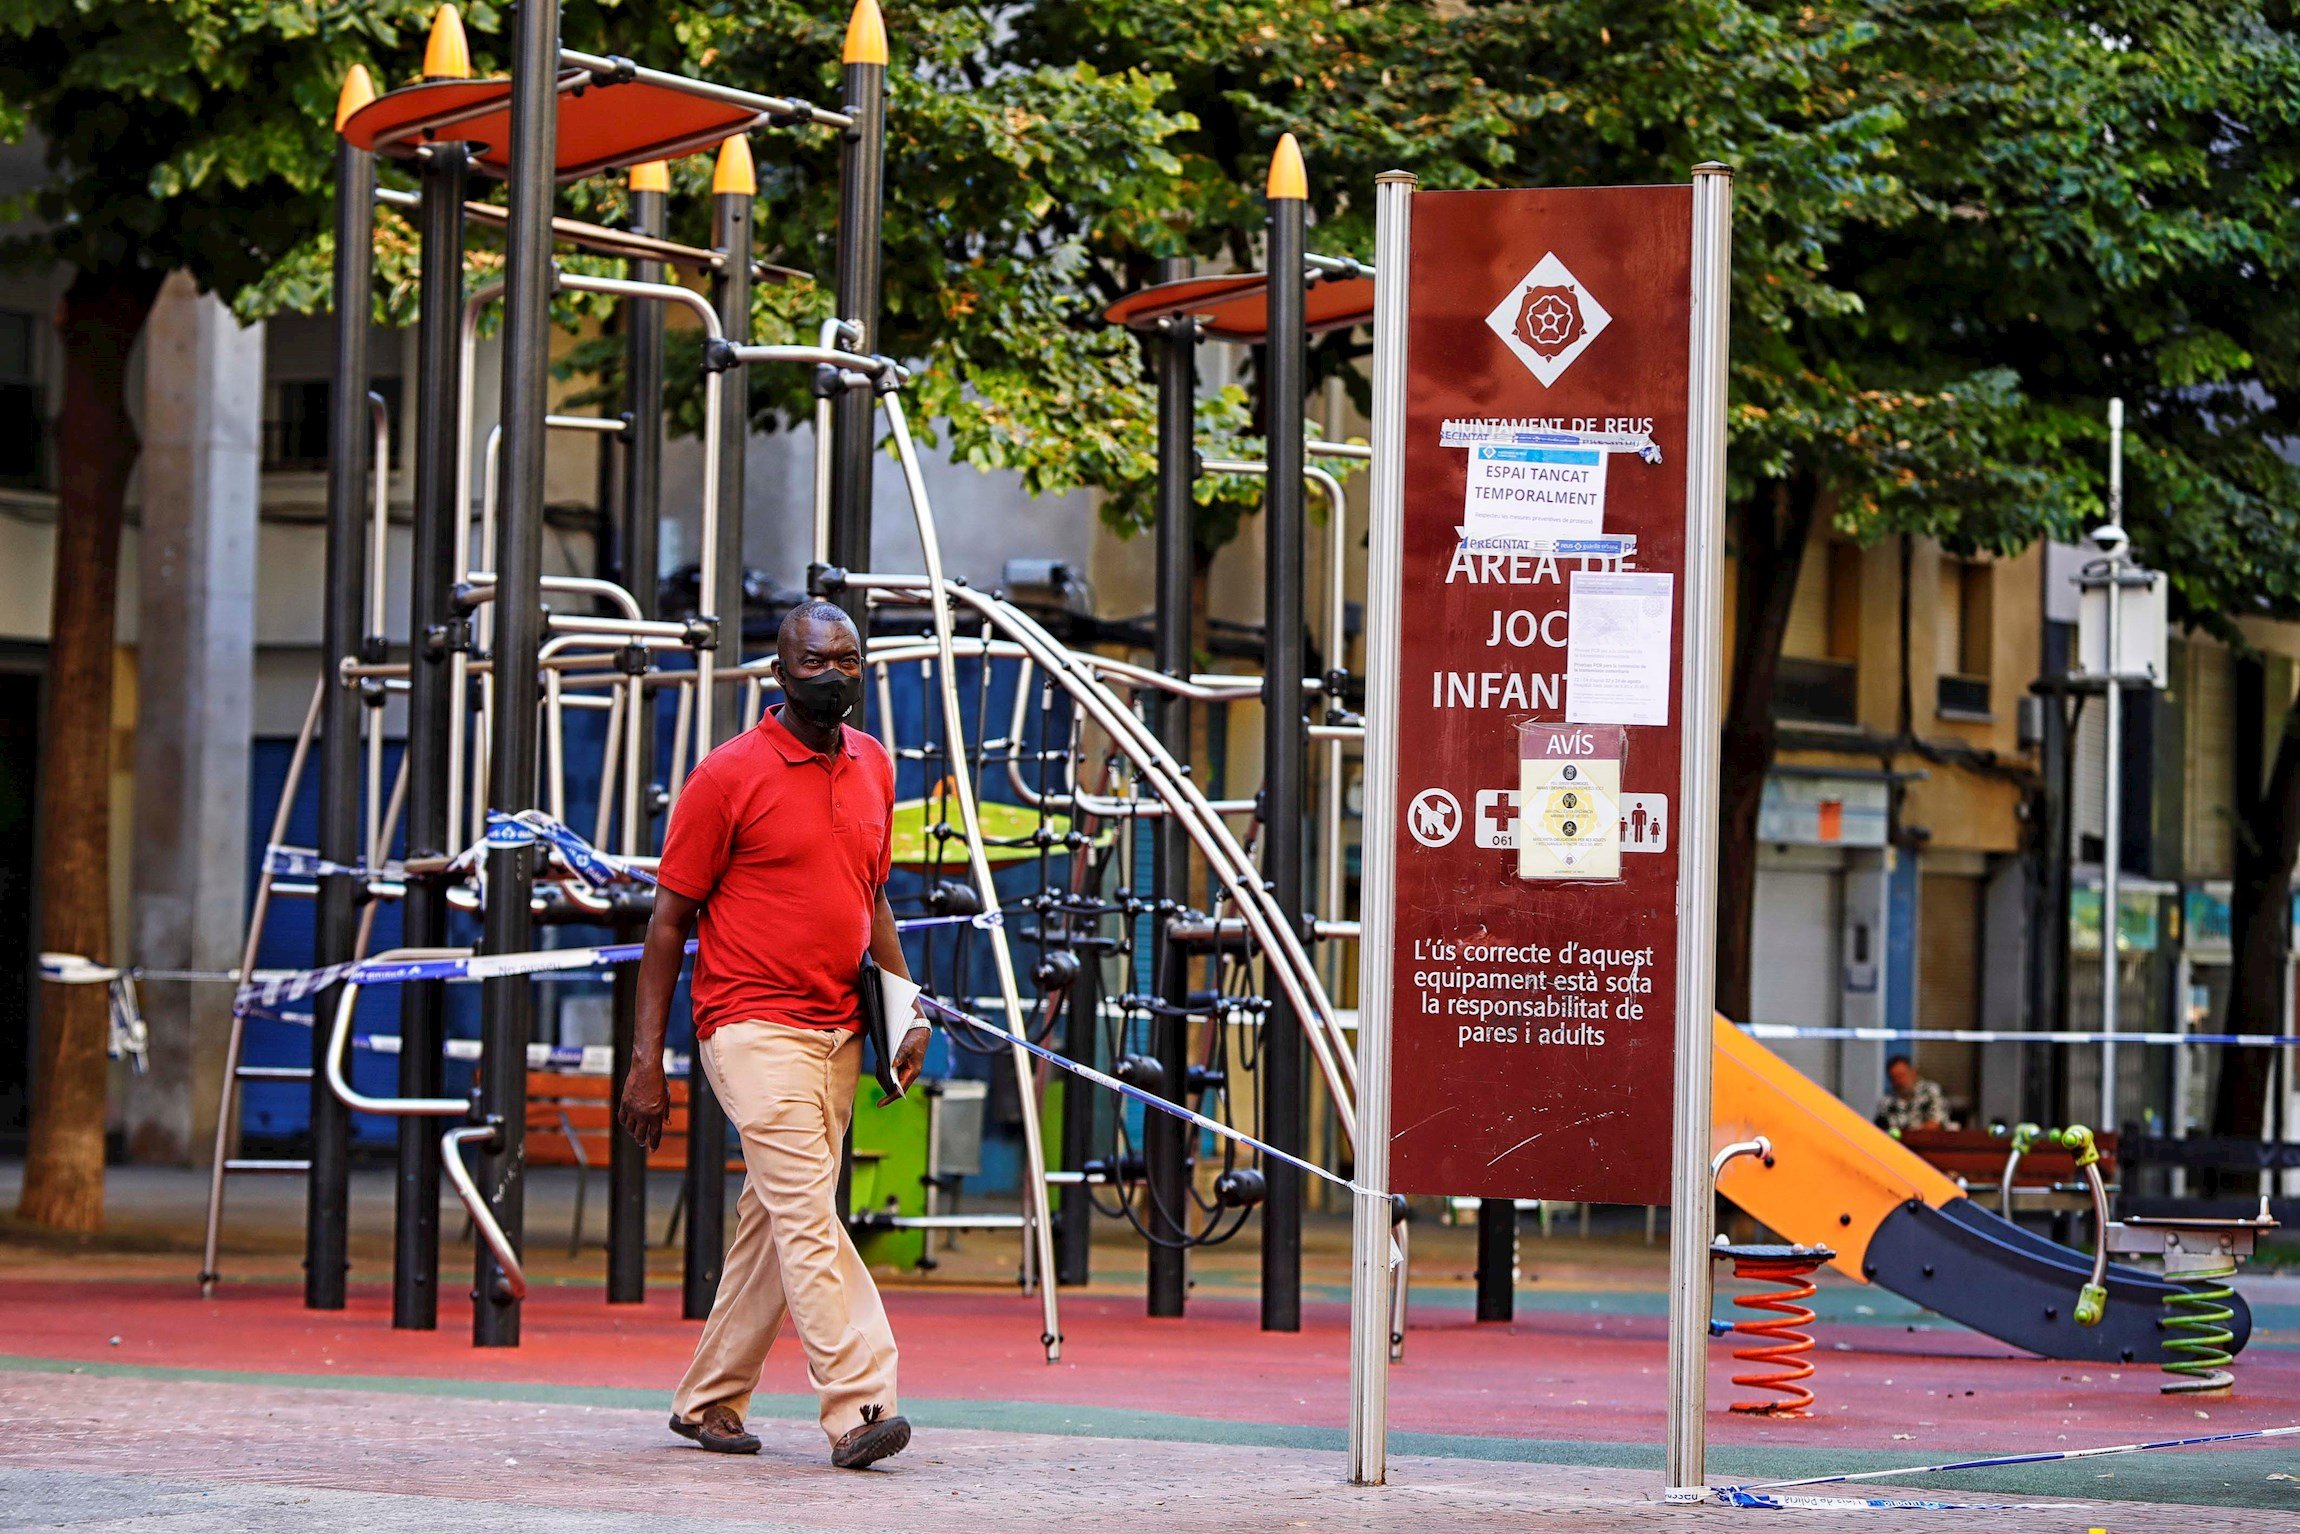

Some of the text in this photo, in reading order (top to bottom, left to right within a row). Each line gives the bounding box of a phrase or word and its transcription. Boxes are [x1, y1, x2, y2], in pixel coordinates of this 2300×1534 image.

[1572, 418, 1597, 433] DE
[1605, 417, 1654, 434] REUS
[1486, 465, 1589, 483] ESPAI TANCAT
[1475, 486, 1597, 505] TEMPORALMENT
[1470, 539, 1530, 549] PRECINTAT
[1433, 671, 1568, 709] INFAN
[1546, 730, 1594, 755] AVÍS
[1492, 836, 1512, 846] 061
[1414, 938, 1653, 972] L'ús correcte d'aquest
[1414, 965, 1652, 994] equipament està sota
[1422, 991, 1644, 1021] la responsabilitat de
[1459, 1021, 1605, 1048] pares i adults
